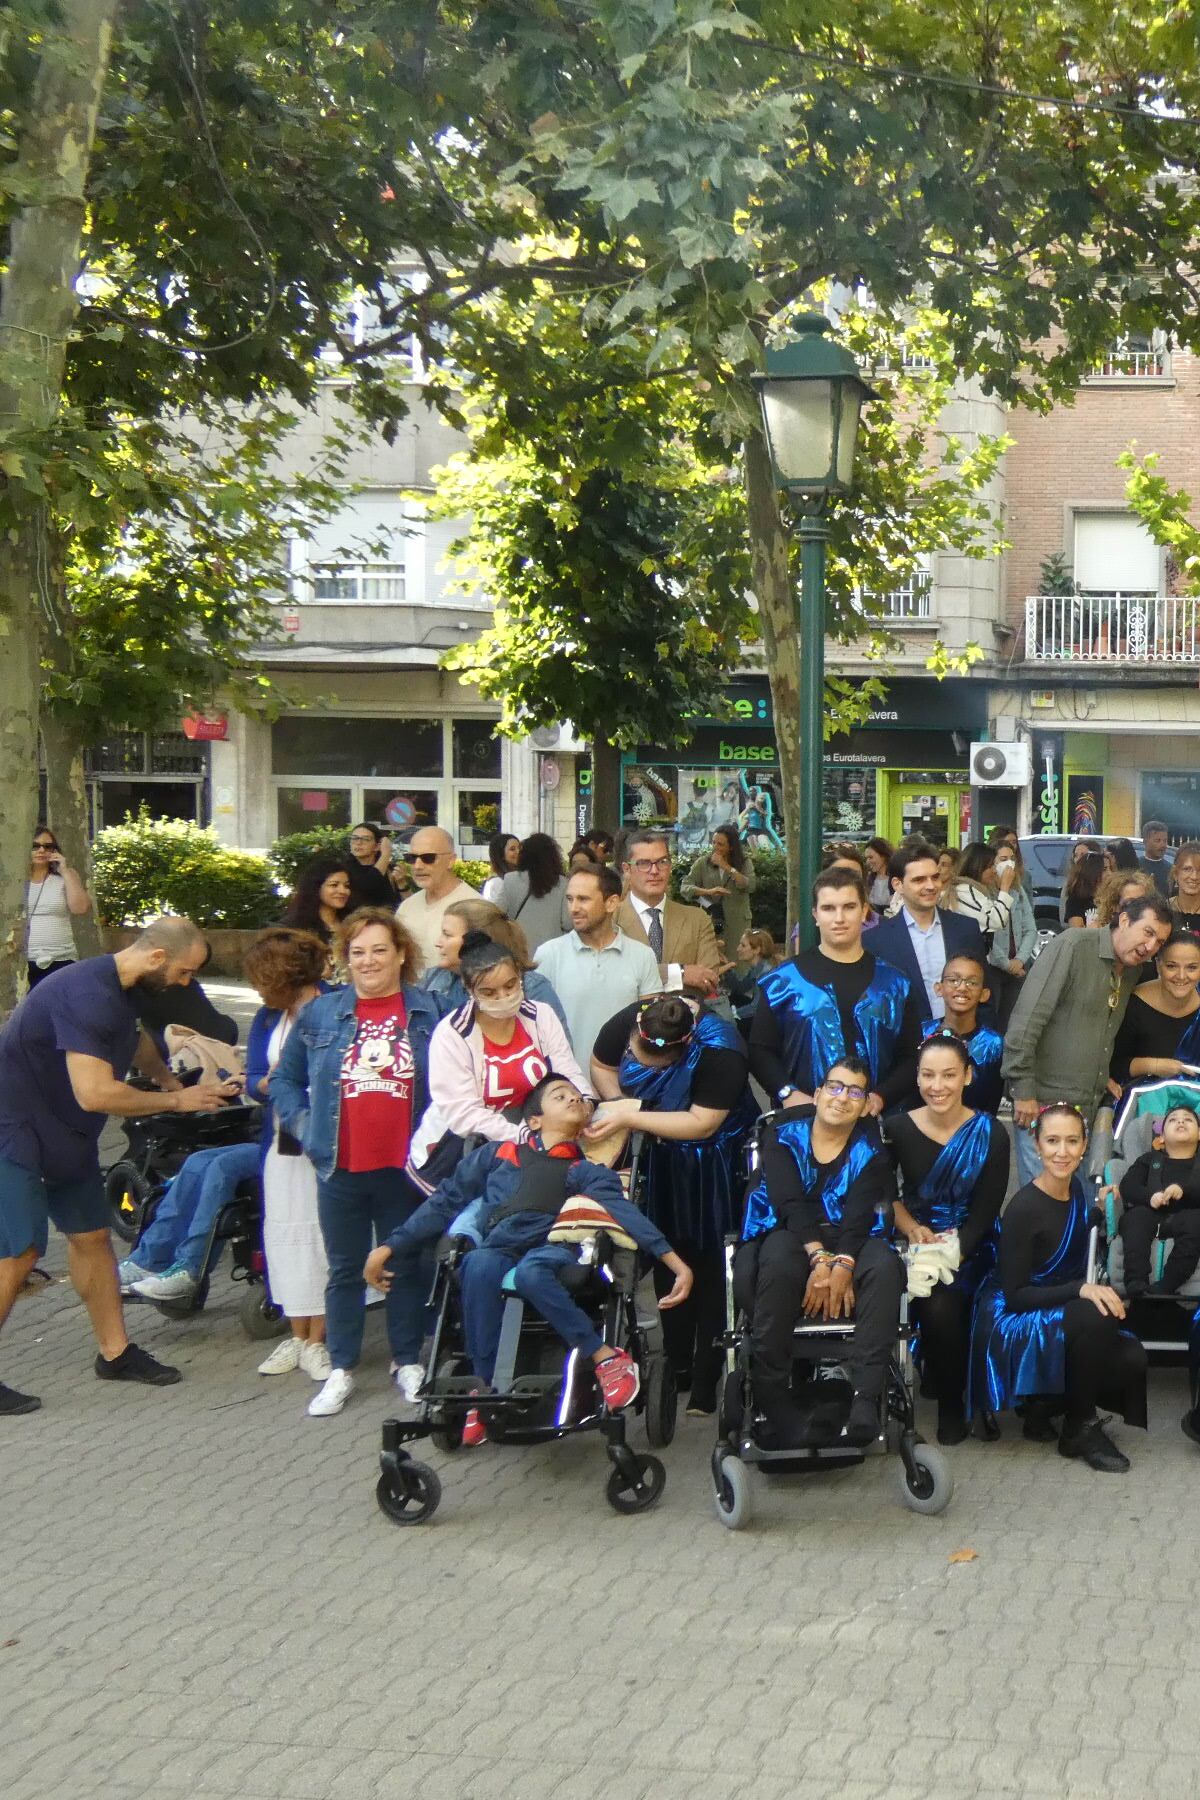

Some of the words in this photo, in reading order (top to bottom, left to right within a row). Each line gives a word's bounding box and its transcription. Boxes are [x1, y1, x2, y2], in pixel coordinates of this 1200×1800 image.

[719, 740, 775, 761] base
[832, 752, 886, 763] Eurotalavera
[354, 1080, 399, 1092] MINNIE
